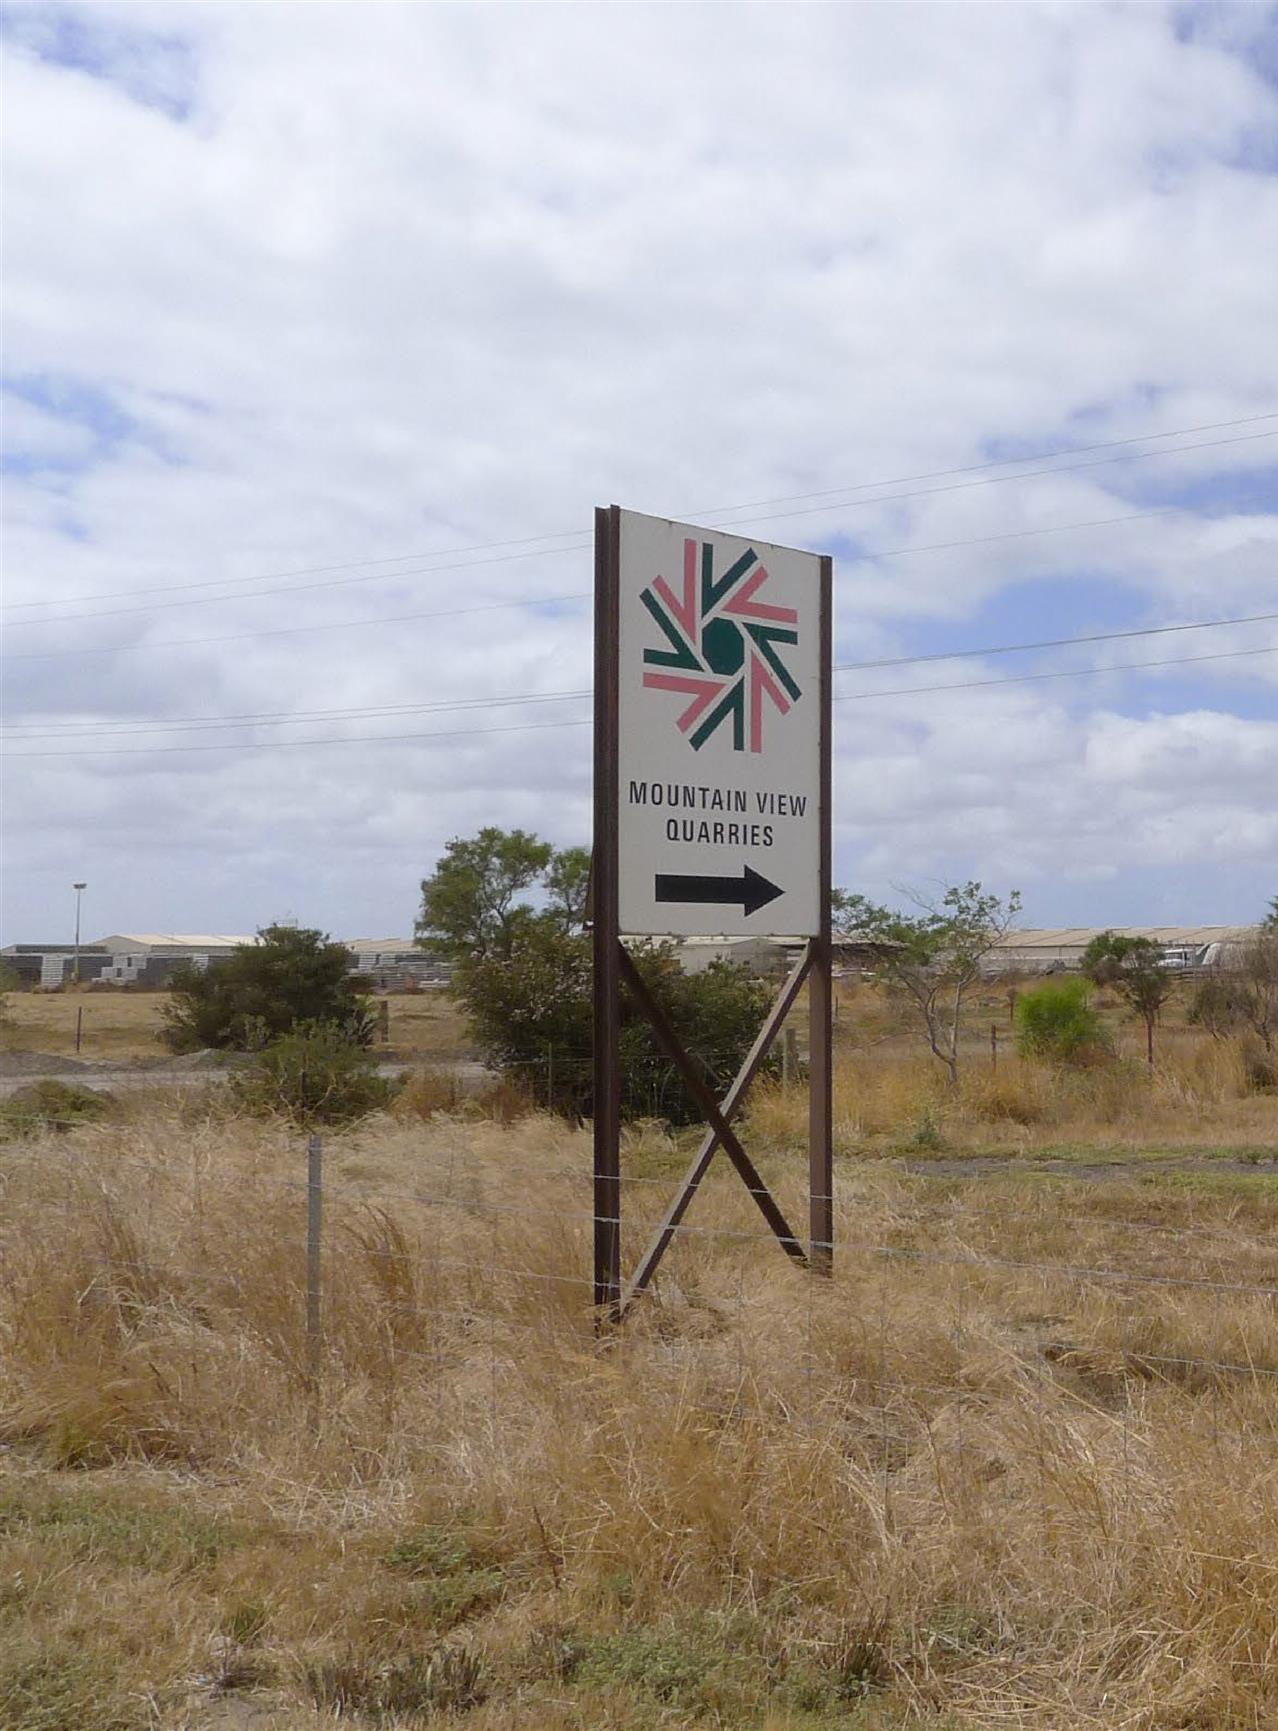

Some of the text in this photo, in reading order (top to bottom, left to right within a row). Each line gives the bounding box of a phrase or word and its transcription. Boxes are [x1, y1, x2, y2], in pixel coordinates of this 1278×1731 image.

[629, 780, 807, 817] MOUNTAIN VIEW
[666, 818, 774, 847] QUARRIES
